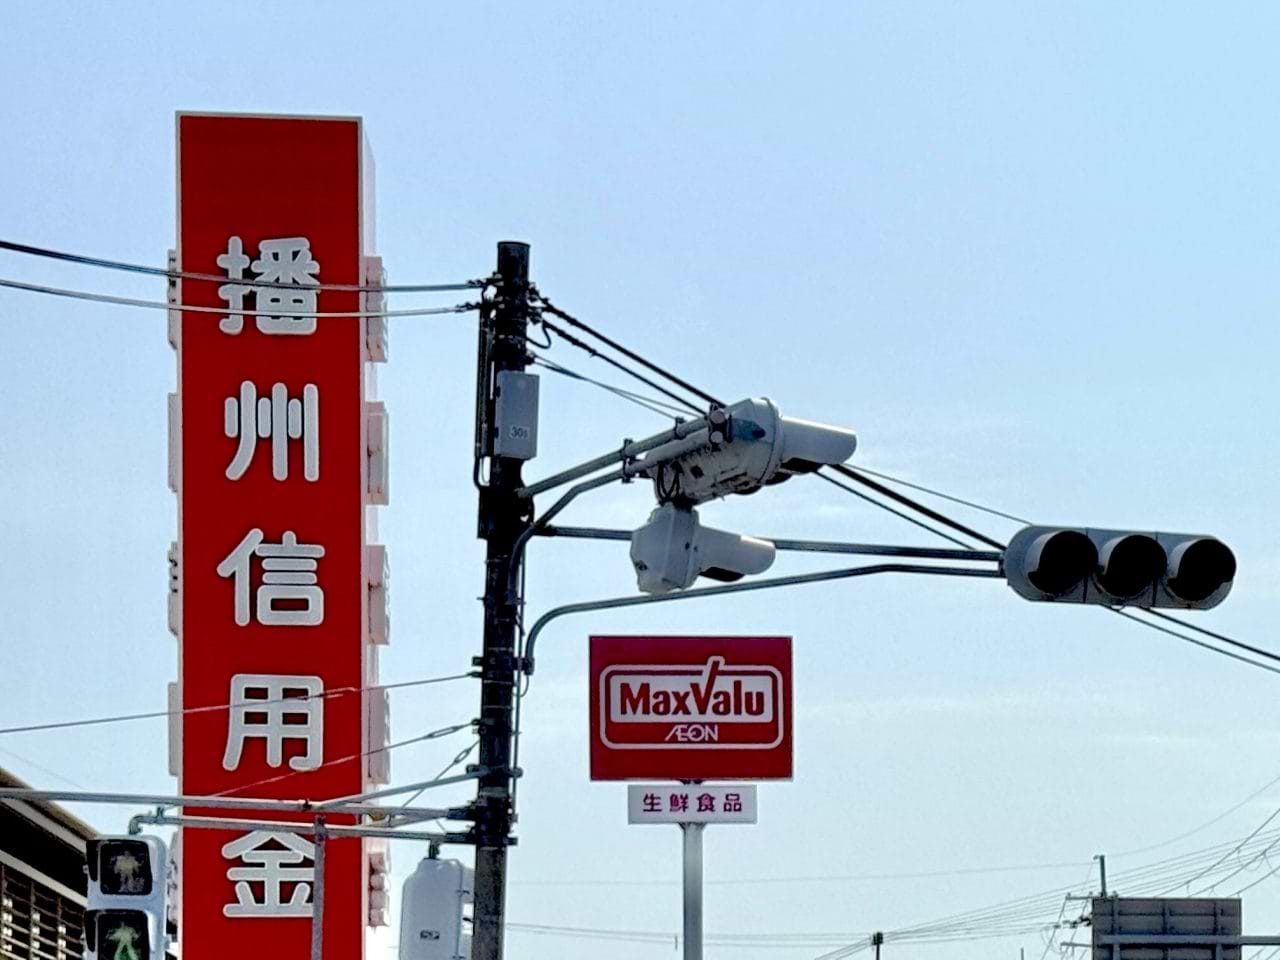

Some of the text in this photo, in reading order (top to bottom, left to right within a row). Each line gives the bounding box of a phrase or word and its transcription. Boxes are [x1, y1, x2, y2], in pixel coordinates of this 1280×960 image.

[619, 660, 765, 716] MaxValu
[642, 793, 743, 813] 生鮮食品
